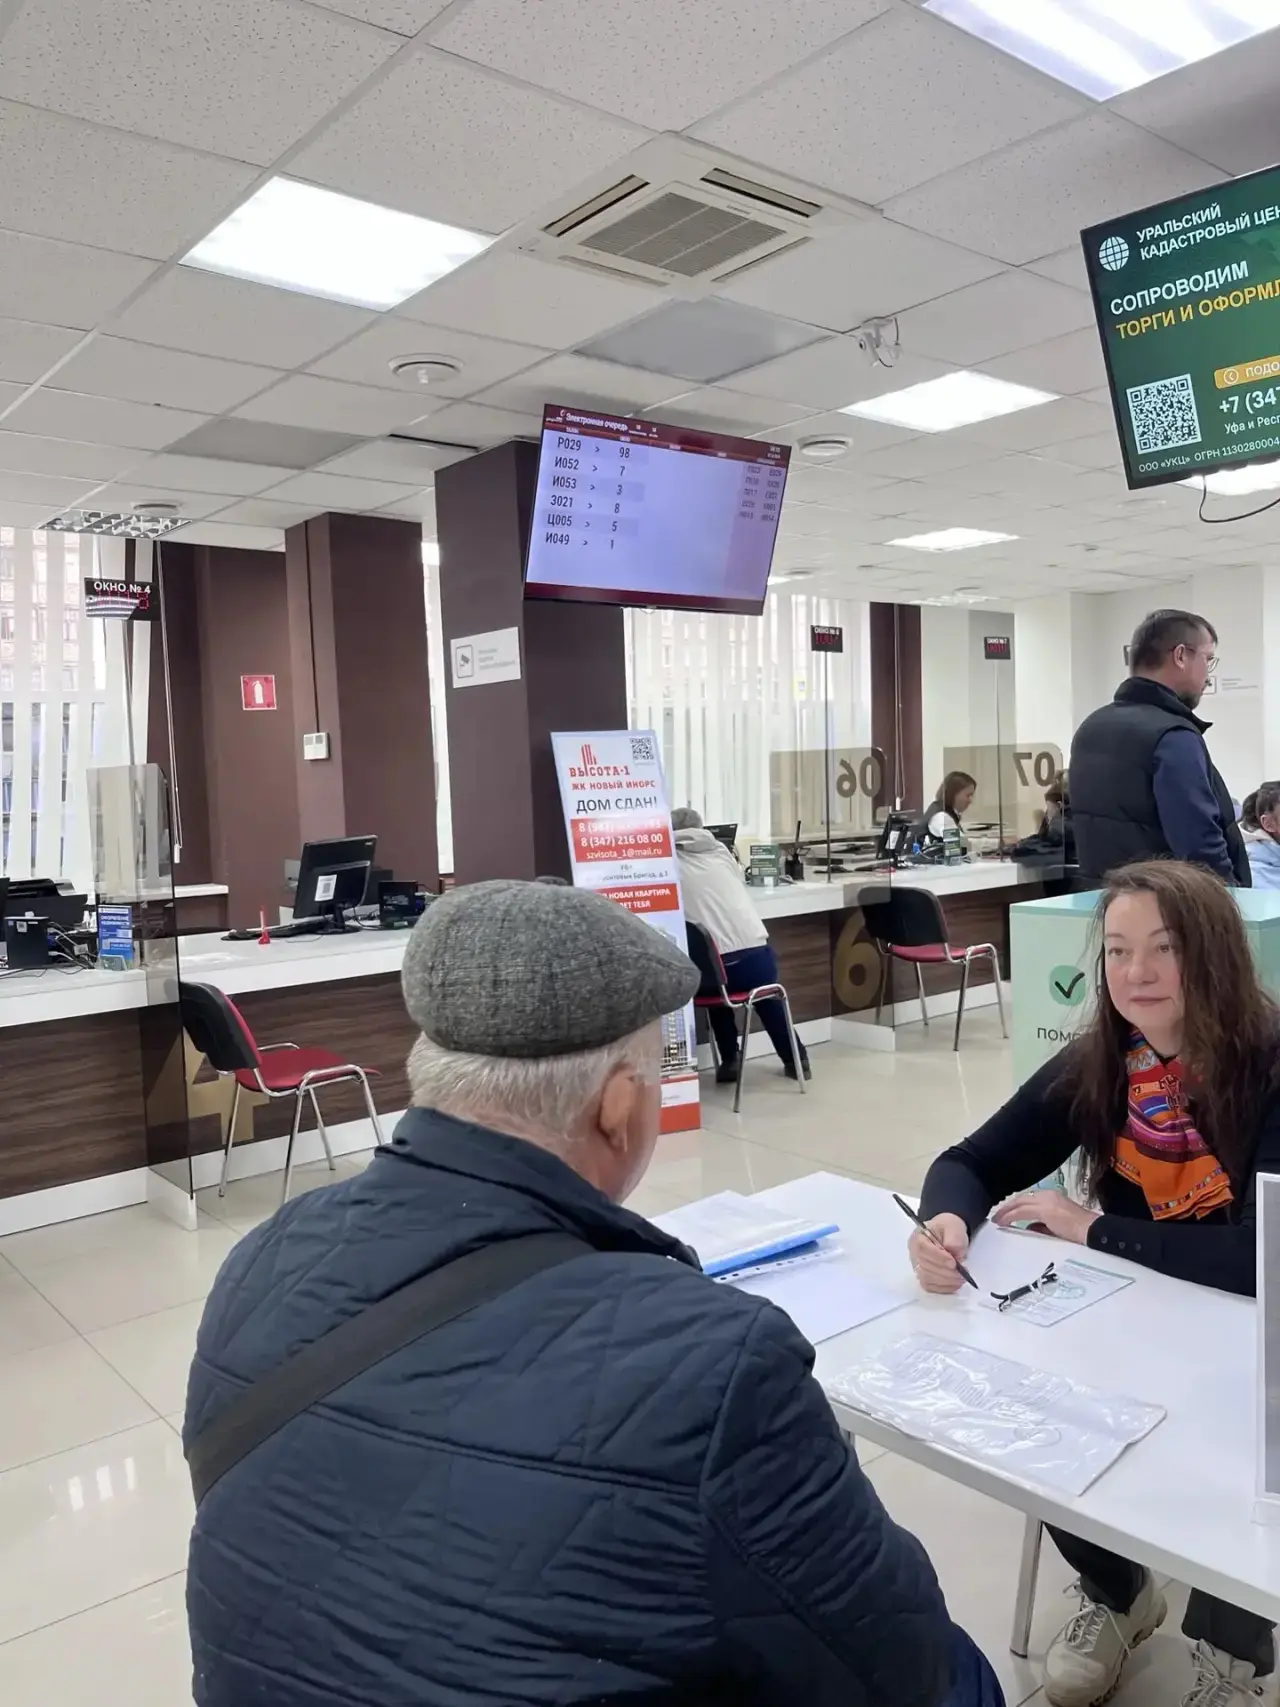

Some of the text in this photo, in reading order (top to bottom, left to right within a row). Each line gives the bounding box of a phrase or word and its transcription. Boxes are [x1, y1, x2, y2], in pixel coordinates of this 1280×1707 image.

[1136, 202, 1221, 243] УРАЛЬСКИЙ
[1140, 212, 1251, 260] КАДАСТРОВЫЙ
[1110, 260, 1249, 315] СОПРОВОДИМ
[1116, 309, 1175, 339] ТОРГИ
[1180, 304, 1194, 322] И
[1219, 396, 1239, 413] +7
[566, 412, 604, 427] Электронная
[1224, 421, 1245, 434] Уфа
[1247, 420, 1255, 429] и
[557, 436, 630, 458] Р029 98
[555, 456, 625, 476] И052 7
[1139, 461, 1159, 472] ООО
[1160, 455, 1191, 468] «УКЦ»
[1194, 448, 1220, 461] ОГРН
[552, 475, 623, 495] И053 3
[614, 502, 620, 513] 8
[547, 513, 618, 532] Ц005 5
[545, 532, 614, 550] И049 1
[93, 581, 151, 594] ОКНО № 4
[572, 780, 656, 790] ЖК НОВЫЙ ИНОРС
[576, 796, 657, 814] ДОМ СДАН!
[581, 833, 663, 848] 8 (347) 216 08 00
[609, 890, 634, 899] НОВАЯ
[635, 888, 671, 897] КВАРТИРА
[633, 900, 651, 908] ТЕБЯ
[833, 907, 883, 1010] 6
